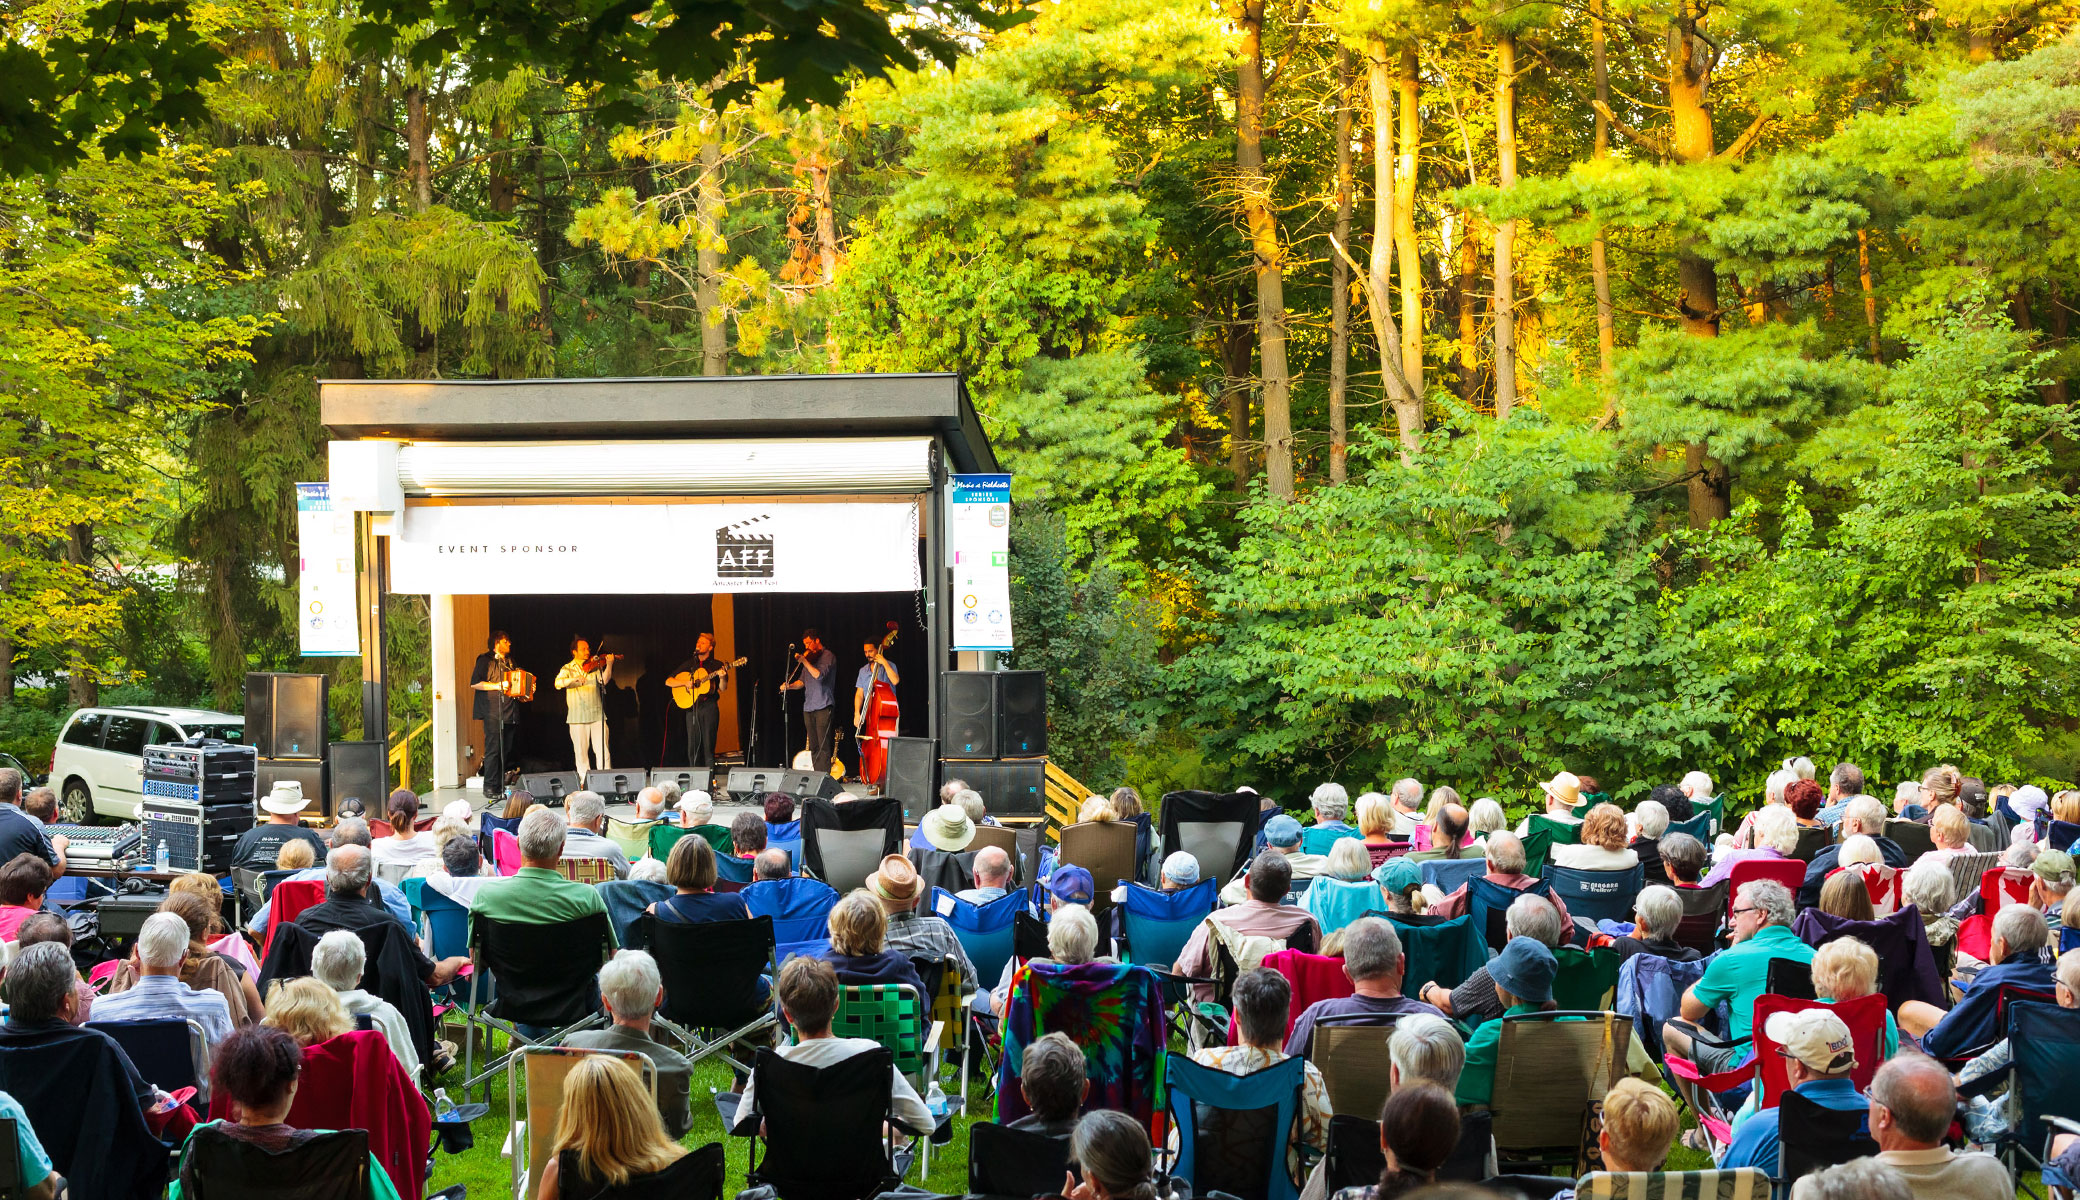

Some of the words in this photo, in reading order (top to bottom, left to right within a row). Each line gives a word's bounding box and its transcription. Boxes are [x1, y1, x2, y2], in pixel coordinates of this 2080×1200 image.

[438, 545, 488, 553] EVENT
[500, 545, 578, 553] SPONSOR
[719, 549, 771, 568] AFF
[1831, 1037, 1848, 1050] BDO
